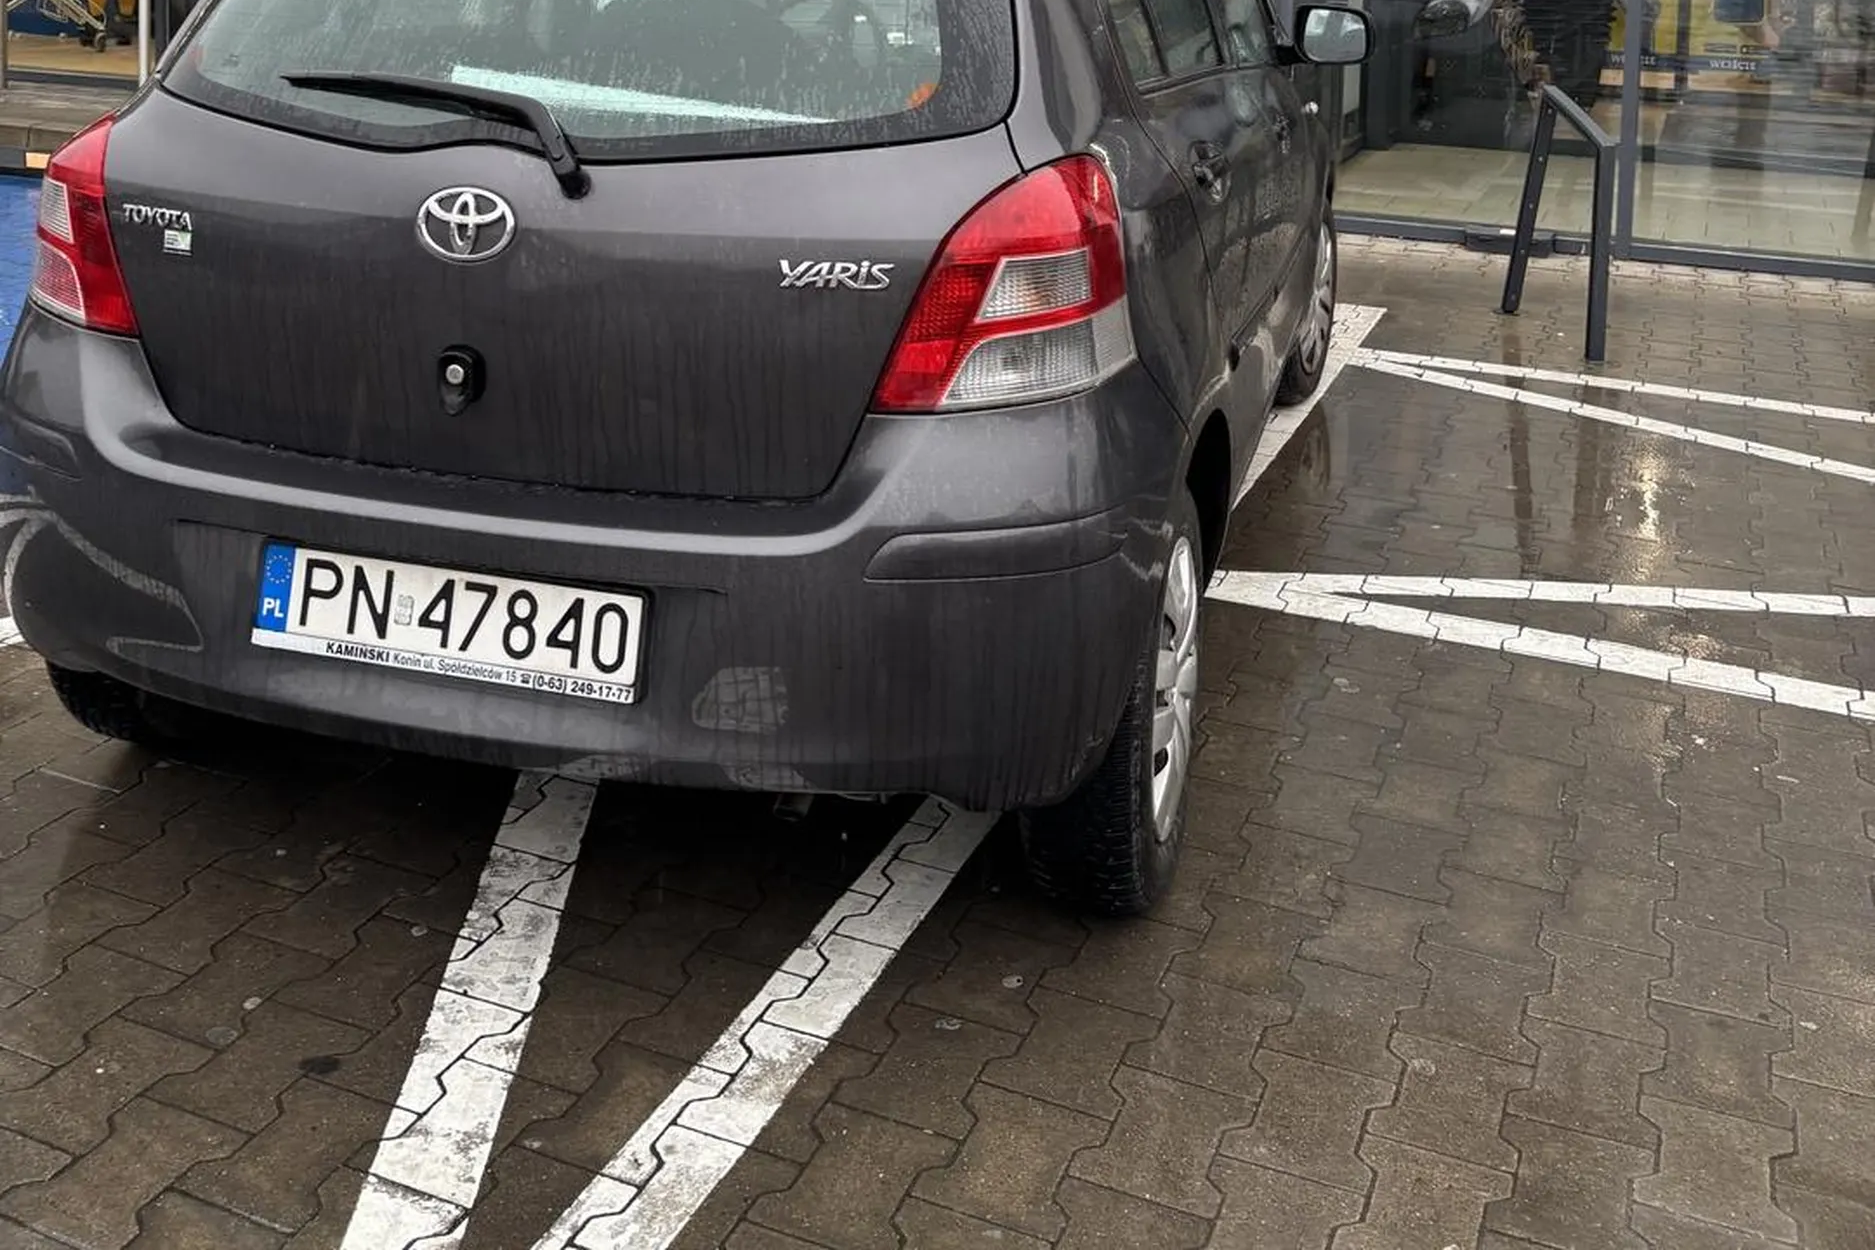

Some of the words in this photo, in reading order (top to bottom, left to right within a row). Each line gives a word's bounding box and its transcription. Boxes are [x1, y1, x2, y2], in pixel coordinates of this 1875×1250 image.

[122, 203, 192, 231] TOYOTA
[262, 597, 285, 618] PL
[299, 557, 395, 640] PN
[418, 578, 629, 674] 47840
[393, 652, 422, 668] Konin
[505, 670, 517, 683] 15
[532, 673, 568, 694] (0-63)
[570, 680, 632, 702] 249-17-77
